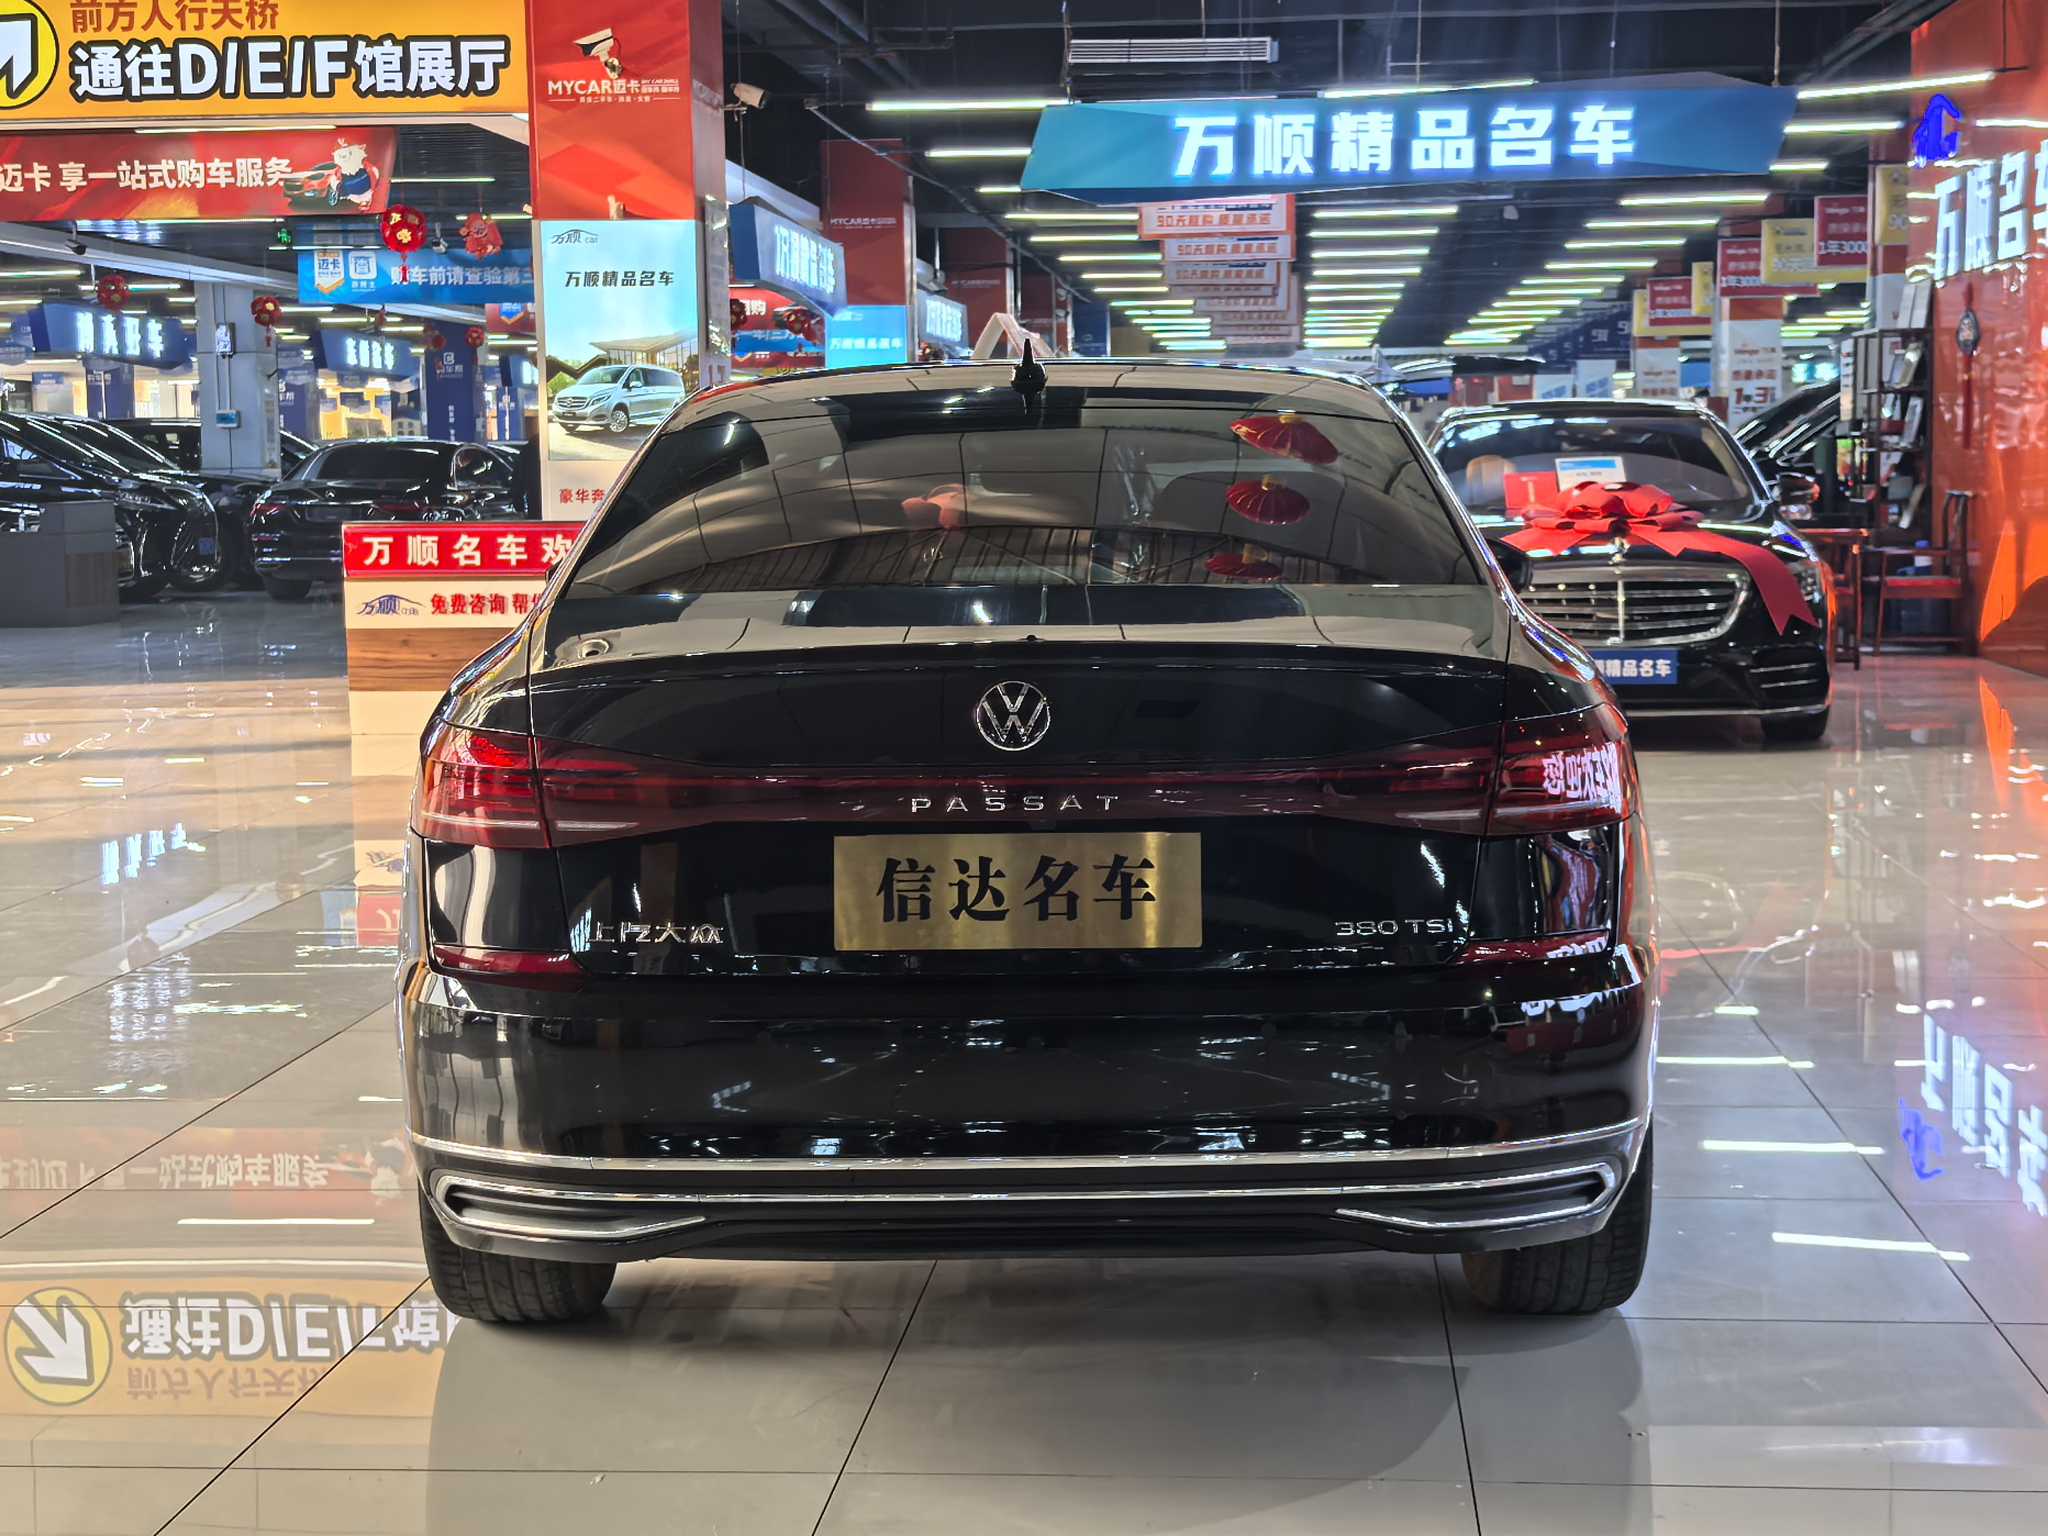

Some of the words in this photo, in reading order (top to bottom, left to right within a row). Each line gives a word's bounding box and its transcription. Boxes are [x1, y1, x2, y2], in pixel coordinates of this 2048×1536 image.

[70, 0, 279, 33] 前方人行天桥
[73, 39, 505, 98] 通往D/E/F馆展厅
[1173, 104, 1637, 178] 万顺精品名车
[0, 162, 51, 193] 迈卡
[58, 158, 293, 192] 享一站式购车服务
[564, 271, 675, 288] 万顺精品名车
[431, 593, 506, 615] 免费咨询
[911, 795, 1119, 813] PASSAT
[875, 853, 1156, 923] 信达名车
[586, 921, 724, 944] 上汽大众
[1334, 919, 1399, 936] 380
[1404, 917, 1454, 934] TSI
